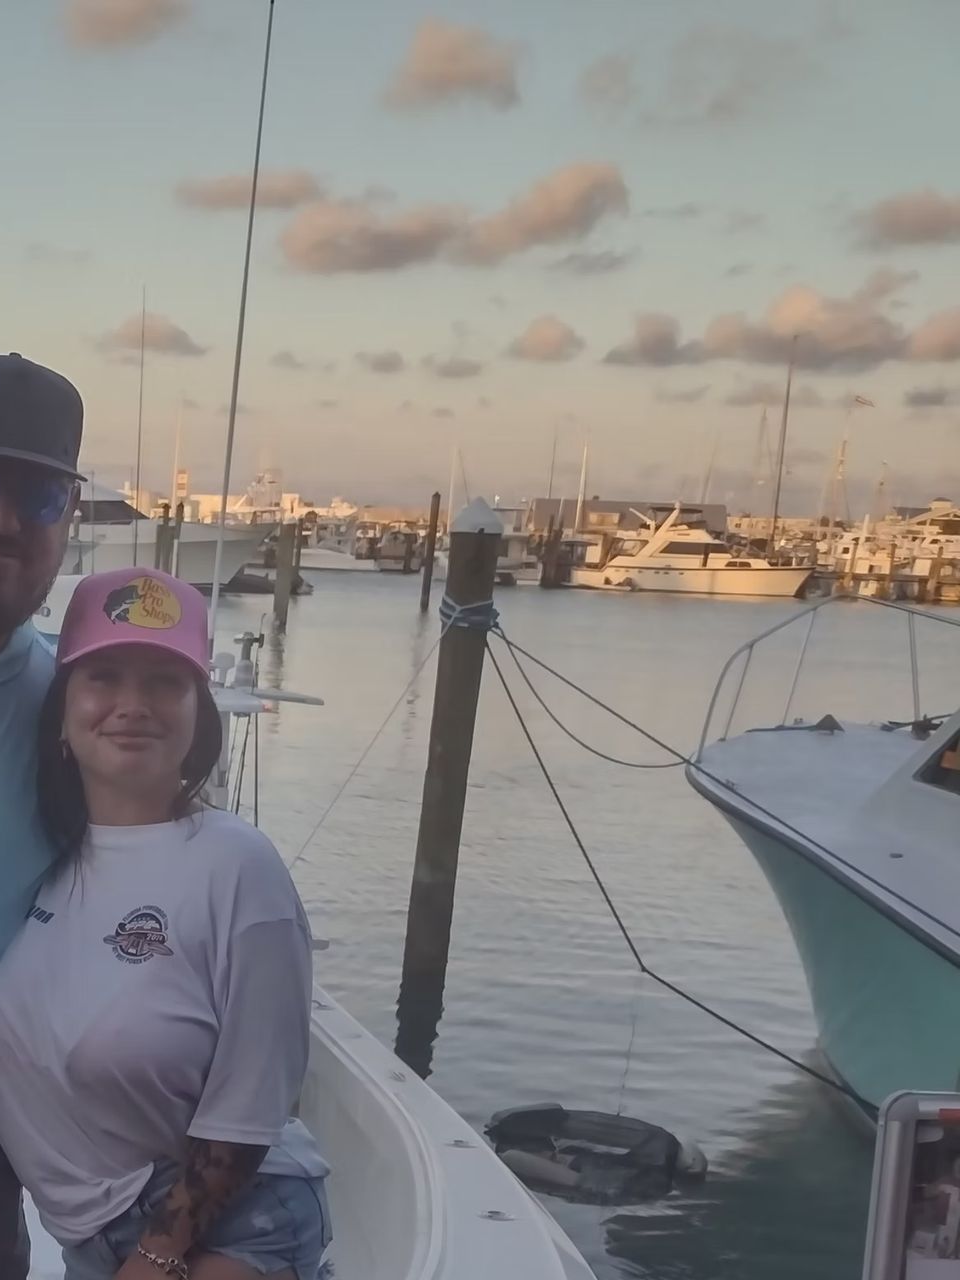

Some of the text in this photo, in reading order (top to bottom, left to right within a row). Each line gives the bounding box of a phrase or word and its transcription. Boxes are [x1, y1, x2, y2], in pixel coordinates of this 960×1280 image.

[141, 578, 171, 598] Bass
[139, 591, 164, 608] Pro
[142, 604, 176, 625] Shops
